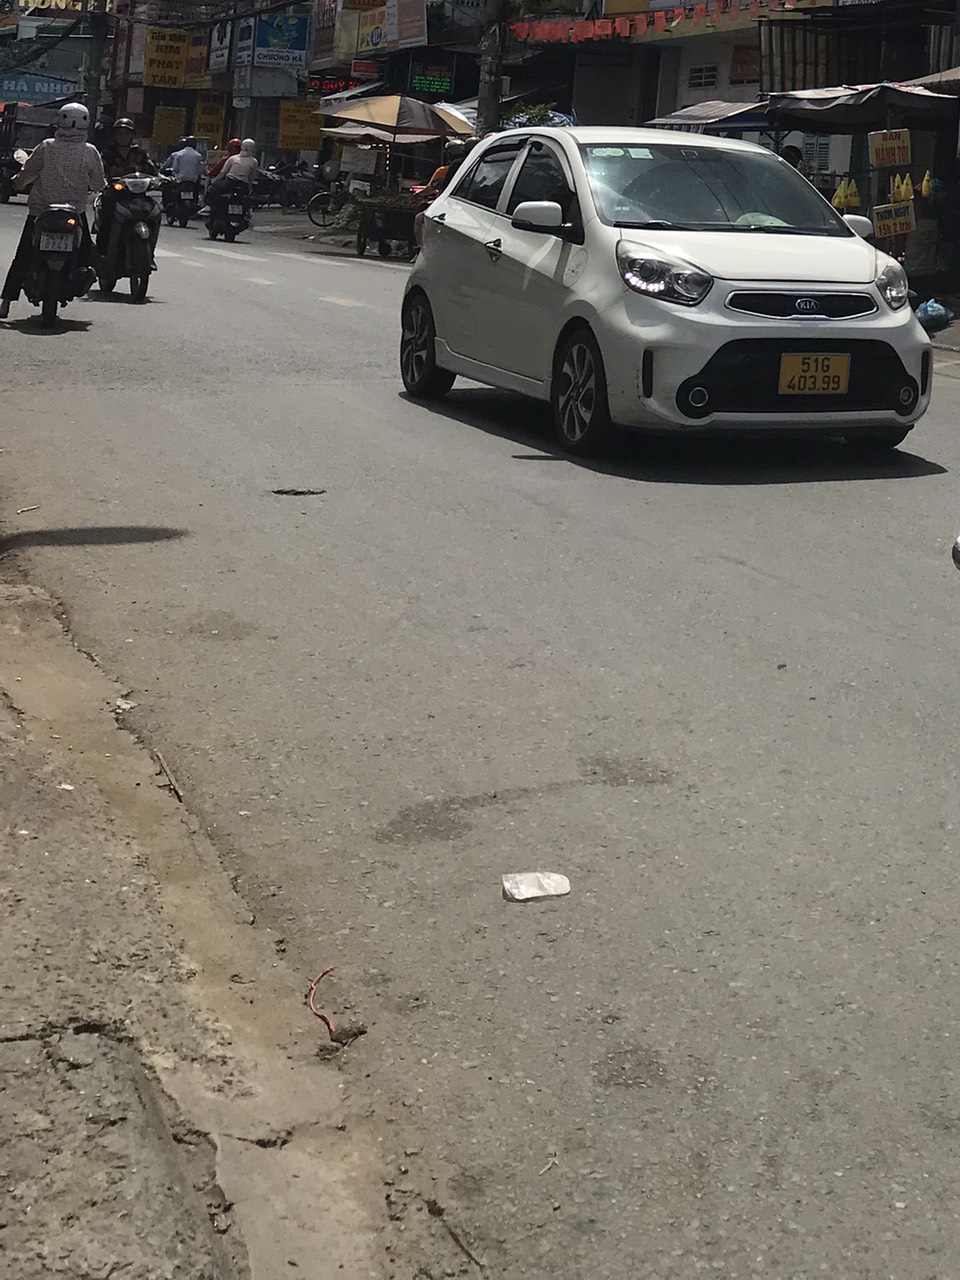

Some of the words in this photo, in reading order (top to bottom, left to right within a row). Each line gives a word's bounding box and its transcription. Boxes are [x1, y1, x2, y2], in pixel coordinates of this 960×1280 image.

[799, 299, 817, 310] KIA
[801, 357, 830, 373] 51G
[787, 374, 841, 392] 403.99
